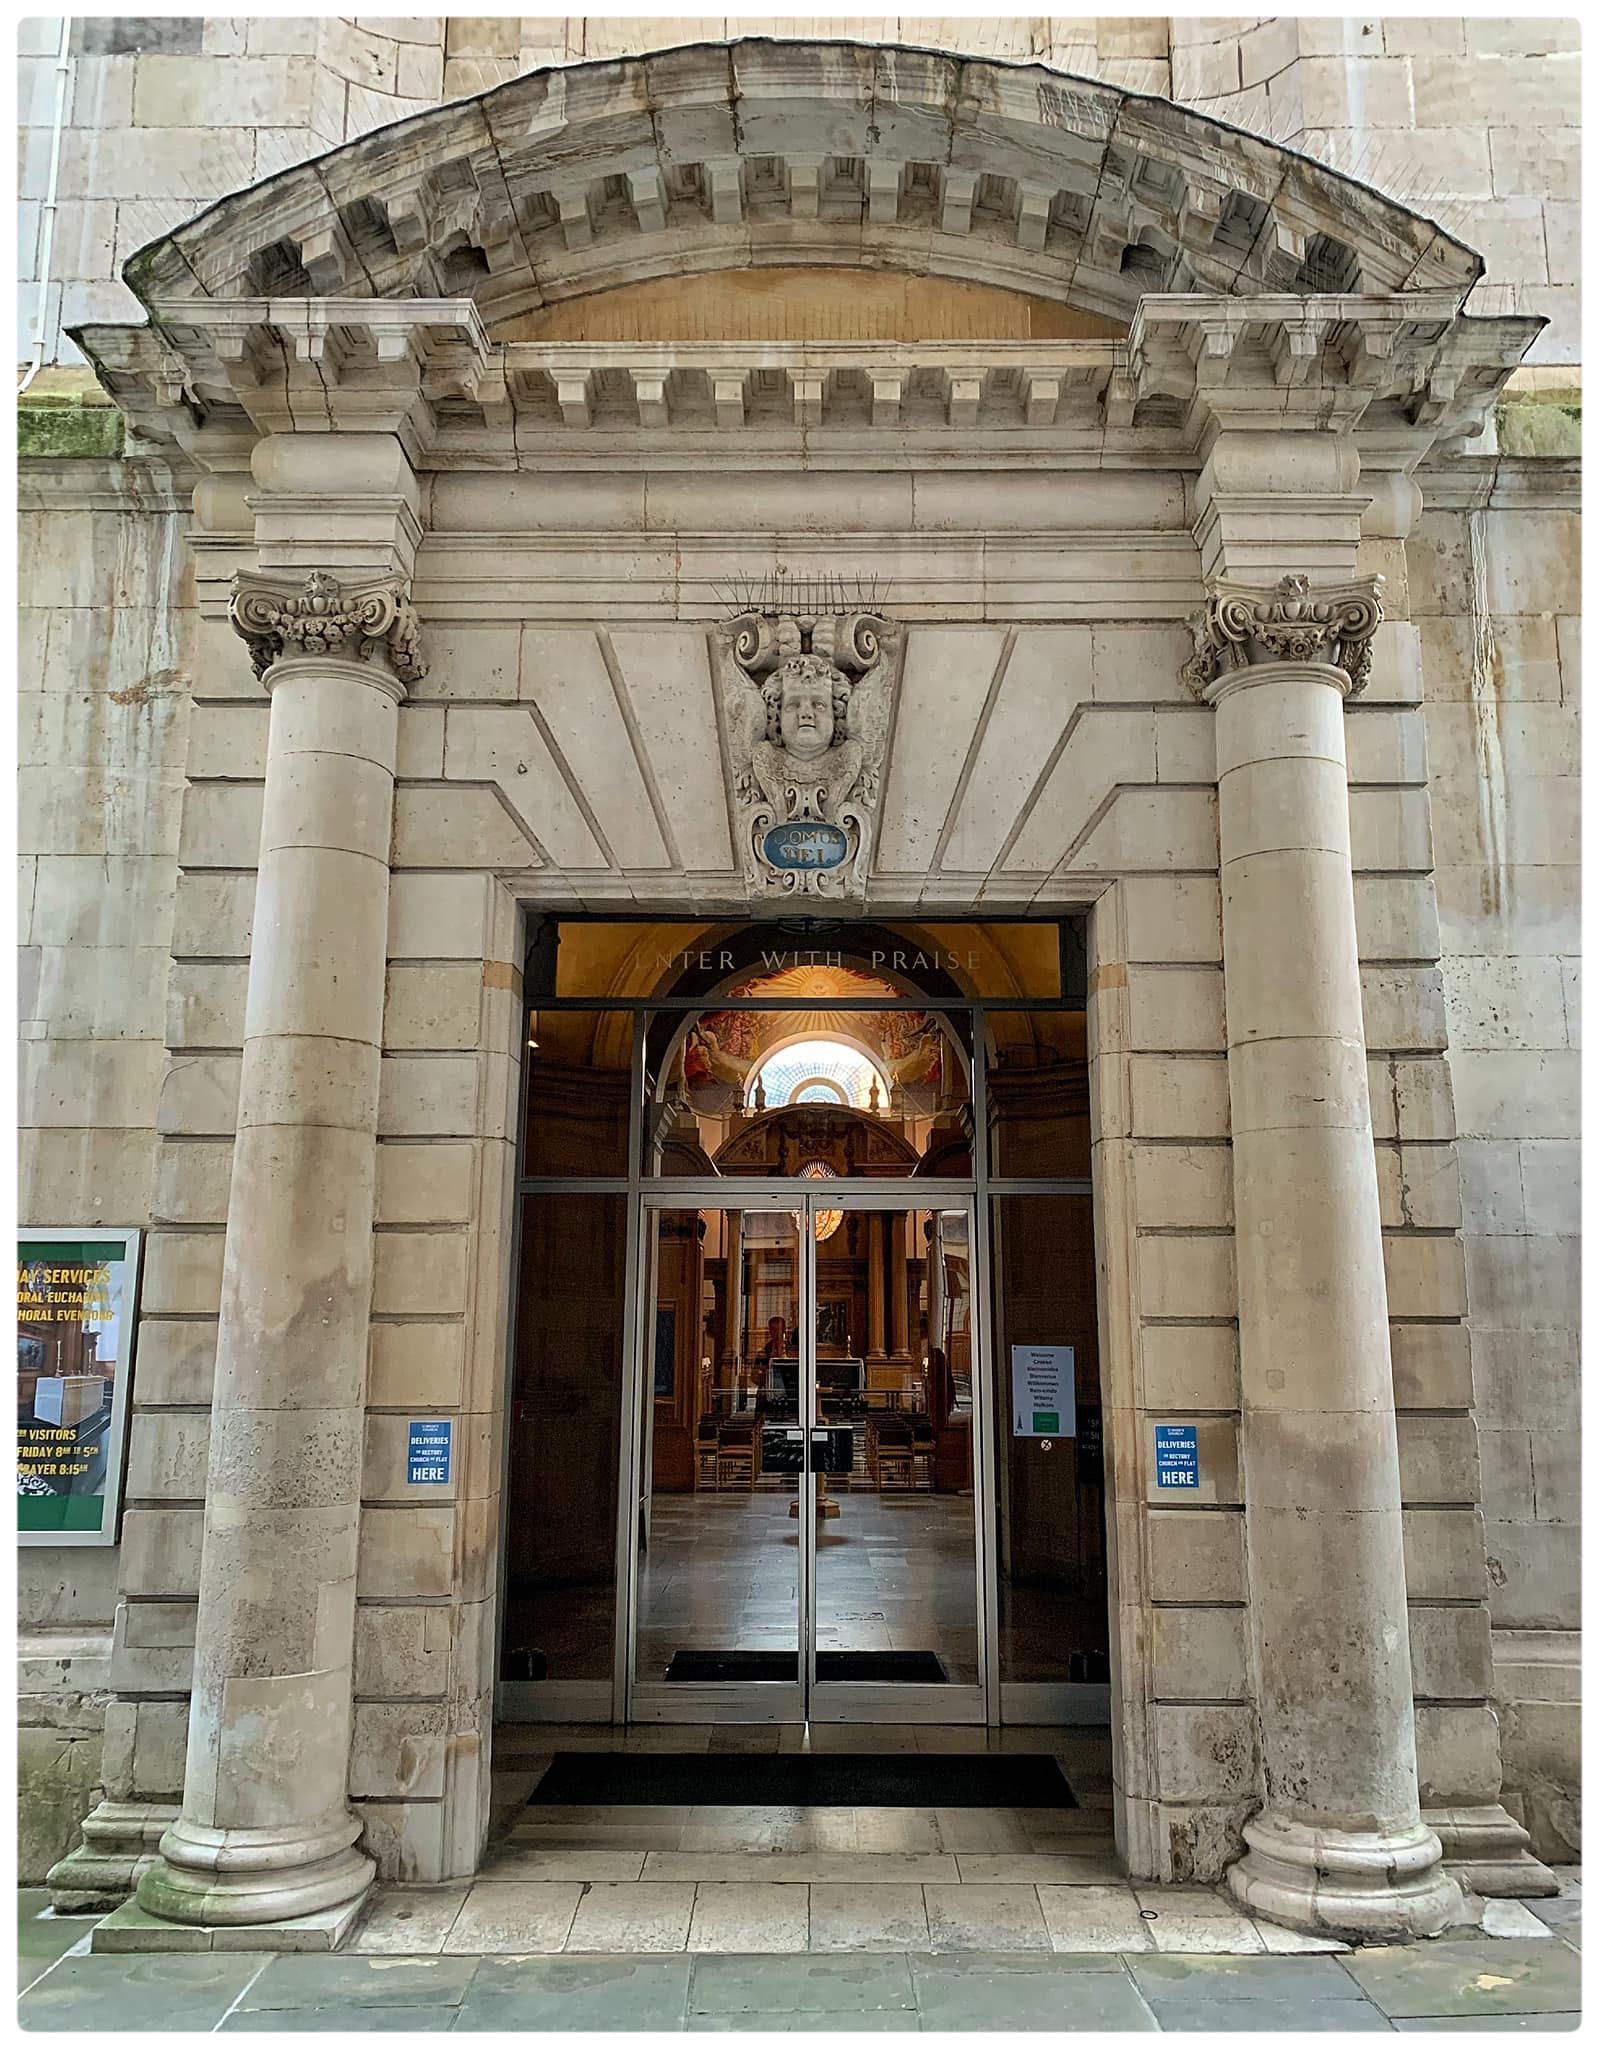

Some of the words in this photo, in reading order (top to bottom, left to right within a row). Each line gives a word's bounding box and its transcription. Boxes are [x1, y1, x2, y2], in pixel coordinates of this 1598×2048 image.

[774, 830, 841, 845] DOMUS
[635, 951, 736, 970] ENTER
[761, 951, 841, 969] WITH
[871, 951, 981, 970] PRAISE
[44, 1269, 111, 1283] SERVICES
[29, 1429, 76, 1440] VISITORS
[411, 1437, 449, 1445] DELIVERIES
[1158, 1441, 1196, 1449] DELIVERIES
[17, 1446, 53, 1457] FRIDAY
[412, 1467, 445, 1480] HERE
[1162, 1472, 1194, 1484] HERE
